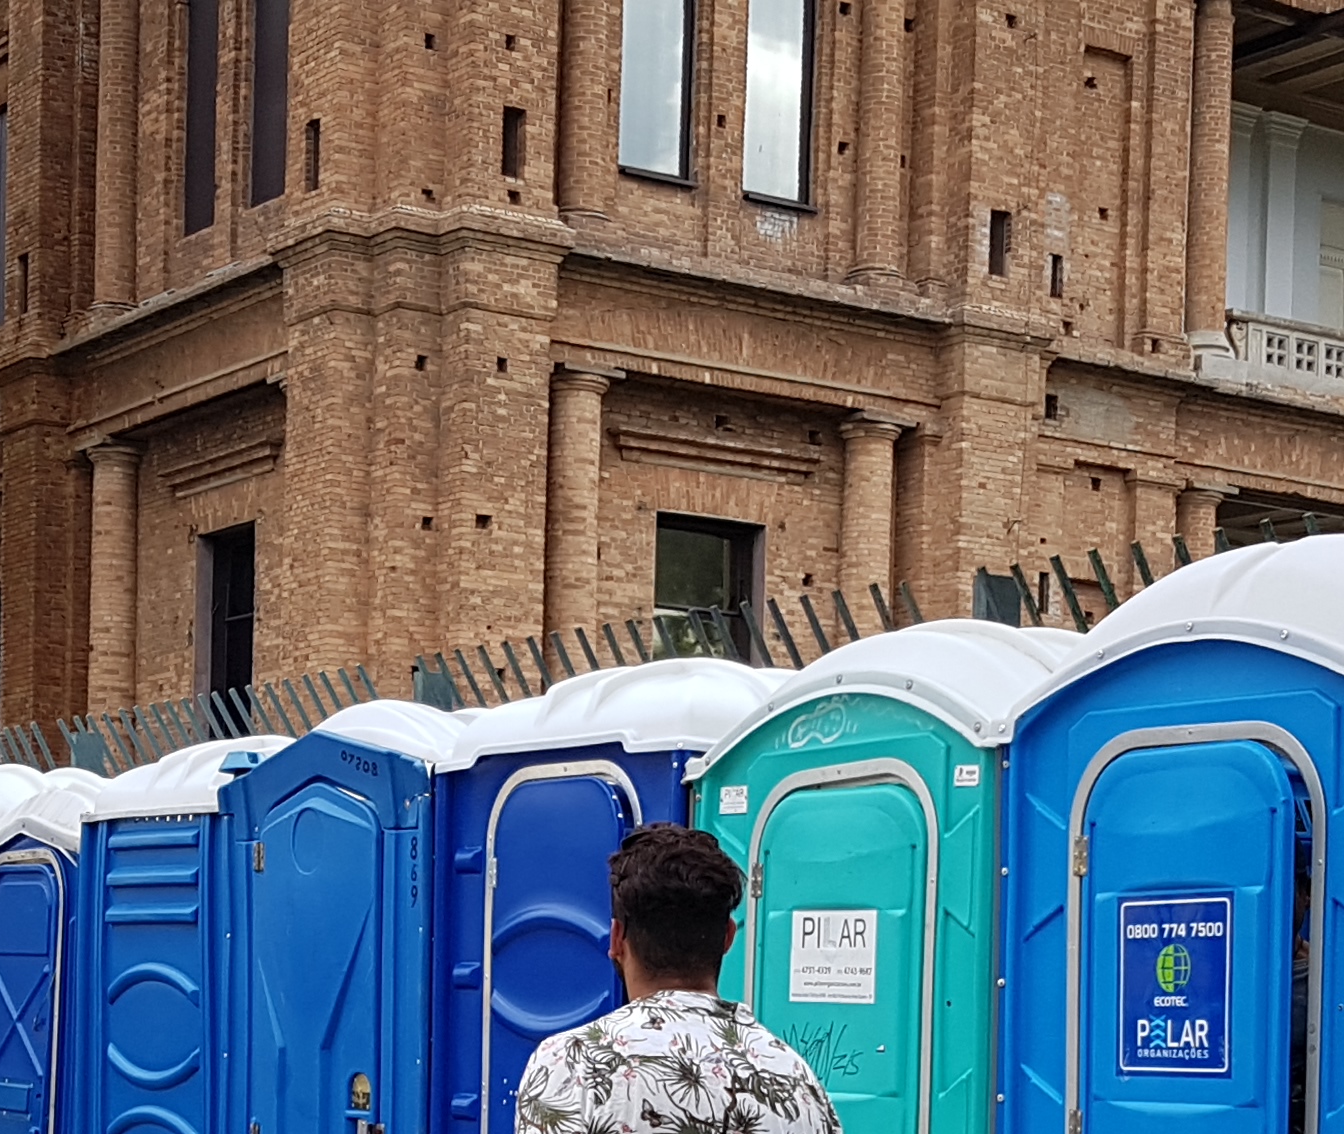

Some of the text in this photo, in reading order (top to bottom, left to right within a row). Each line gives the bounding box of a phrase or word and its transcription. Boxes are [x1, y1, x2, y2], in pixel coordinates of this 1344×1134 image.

[801, 917, 867, 949] PILAR
[1126, 922, 1224, 939] 0800 774 7500
[1153, 996, 1188, 1008] ECOTEC
[1137, 1047, 1210, 1060] ORGANIZAÇÕES
